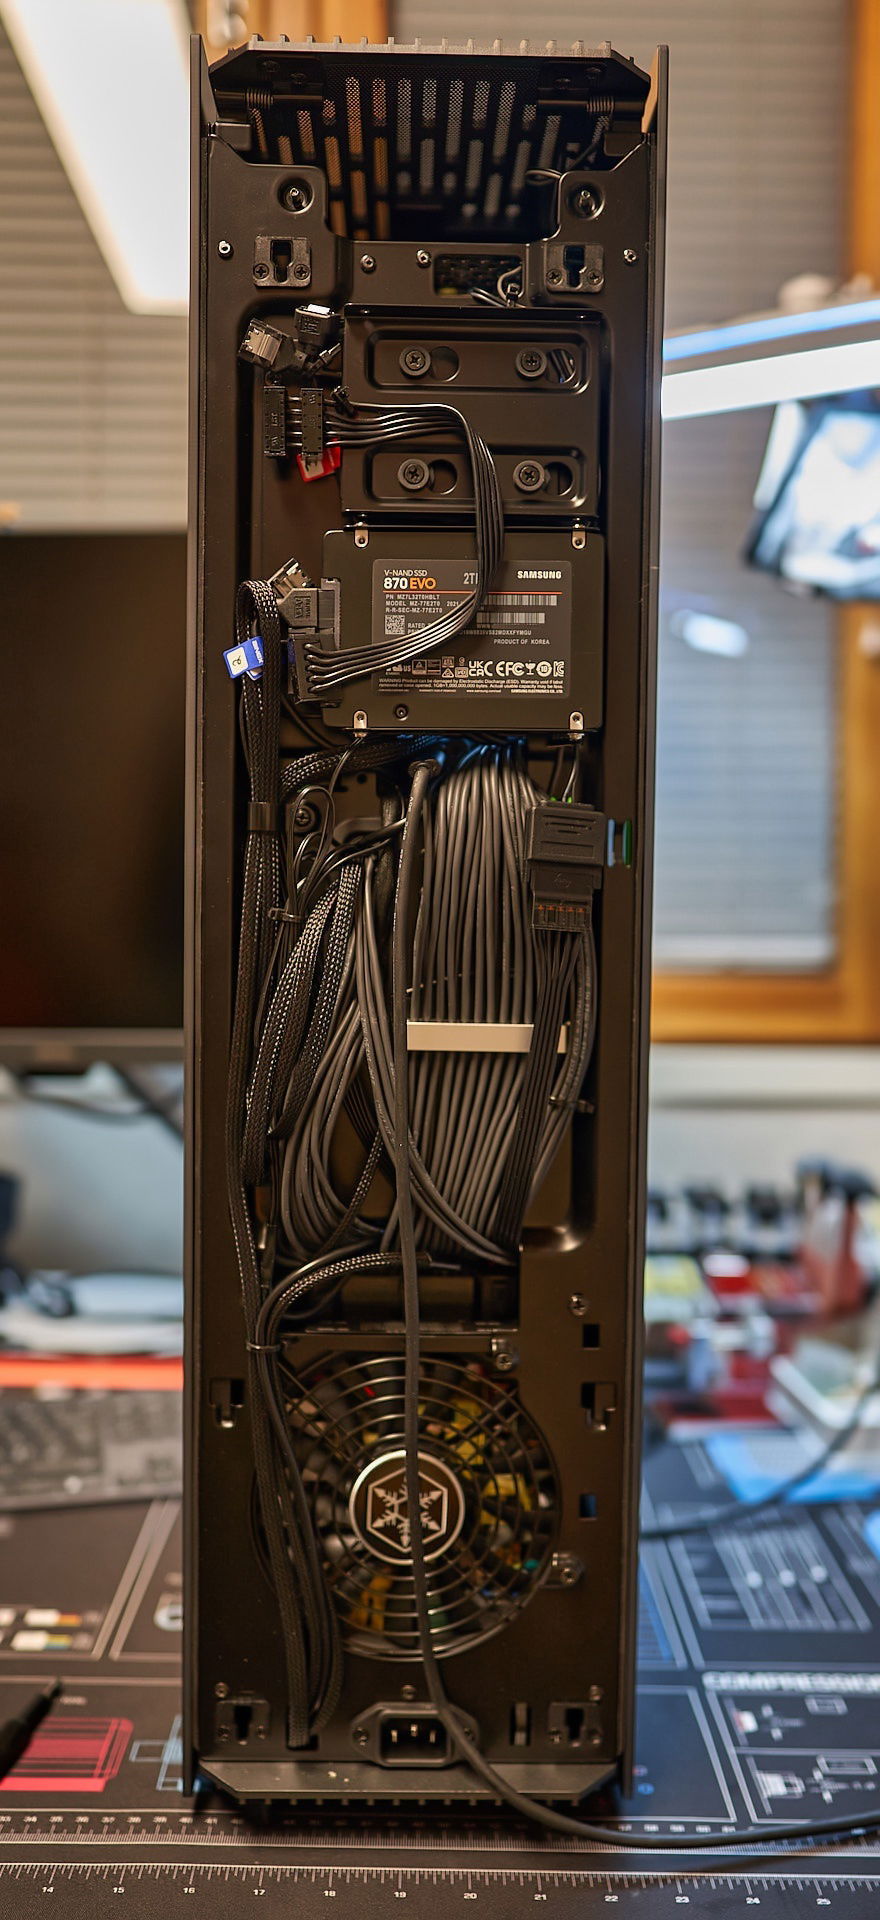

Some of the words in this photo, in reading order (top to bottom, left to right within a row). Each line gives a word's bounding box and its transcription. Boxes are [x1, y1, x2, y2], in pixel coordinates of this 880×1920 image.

[463, 572, 478, 584] 2T
[517, 570, 562, 579] SAMSUNG
[384, 578, 408, 590] 870
[410, 578, 436, 590] EVO
